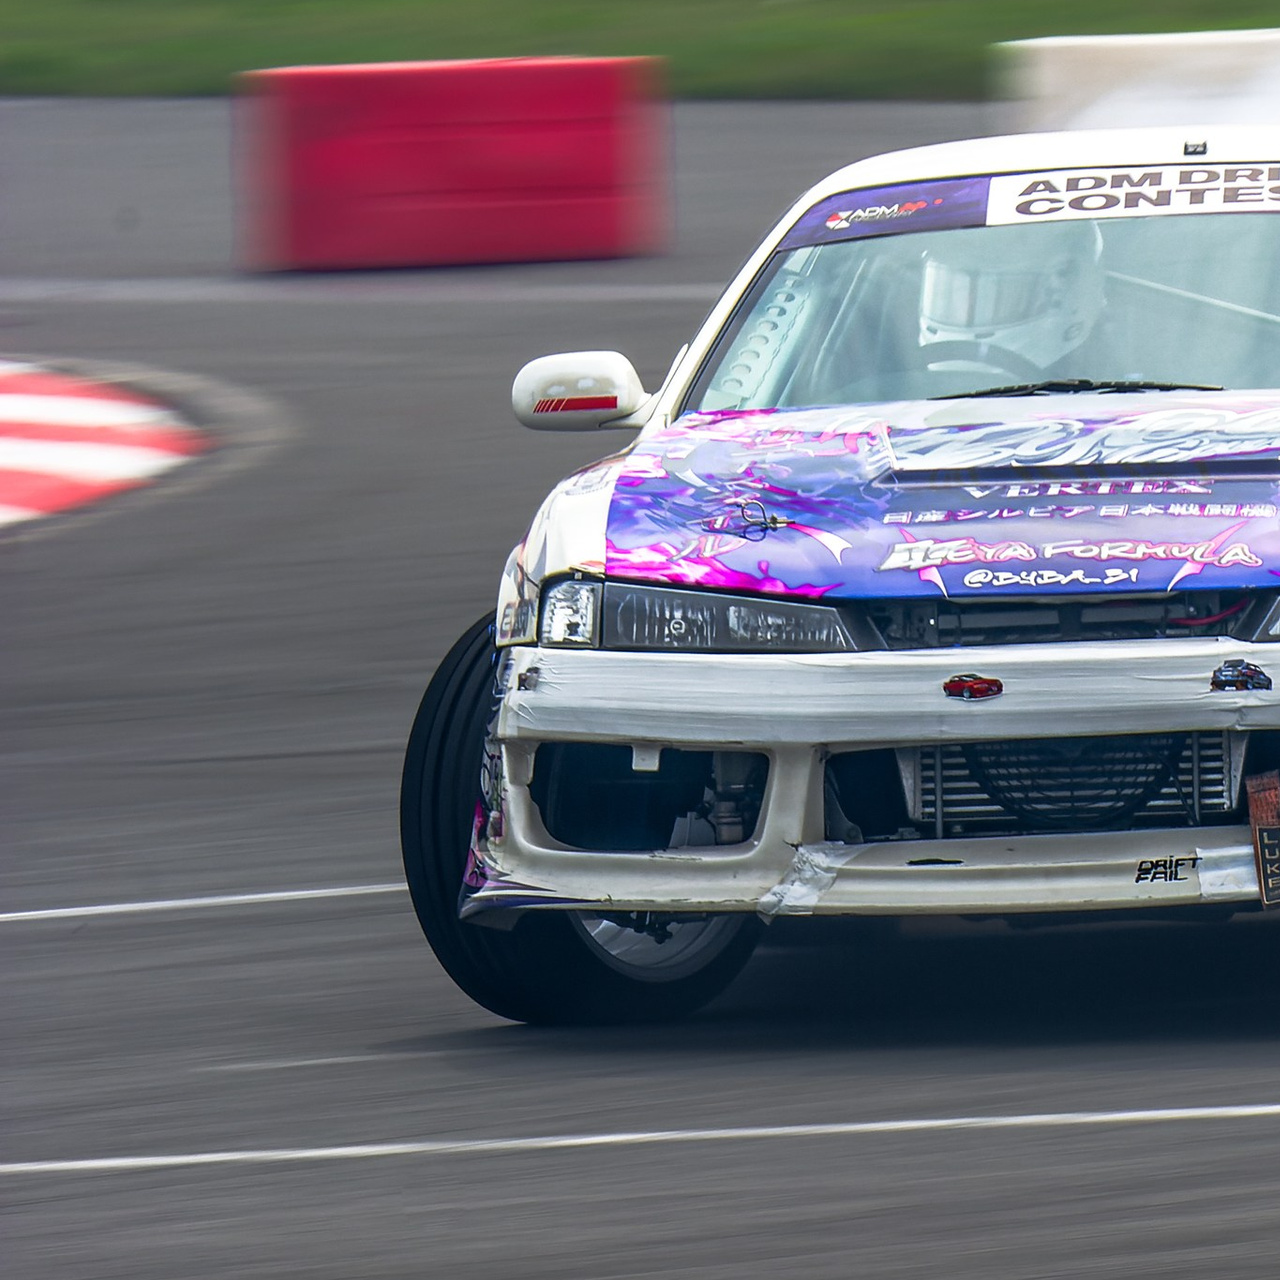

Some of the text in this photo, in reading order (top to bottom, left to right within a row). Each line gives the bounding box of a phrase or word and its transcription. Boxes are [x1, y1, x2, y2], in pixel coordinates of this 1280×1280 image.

[1018, 172, 1163, 196] ADM
[849, 203, 900, 222] ADM
[962, 479, 1215, 499] VERTEX
[1041, 539, 1263, 567] FORMULA
[1137, 855, 1203, 871] DRIFT
[1135, 870, 1188, 884] FAIL
